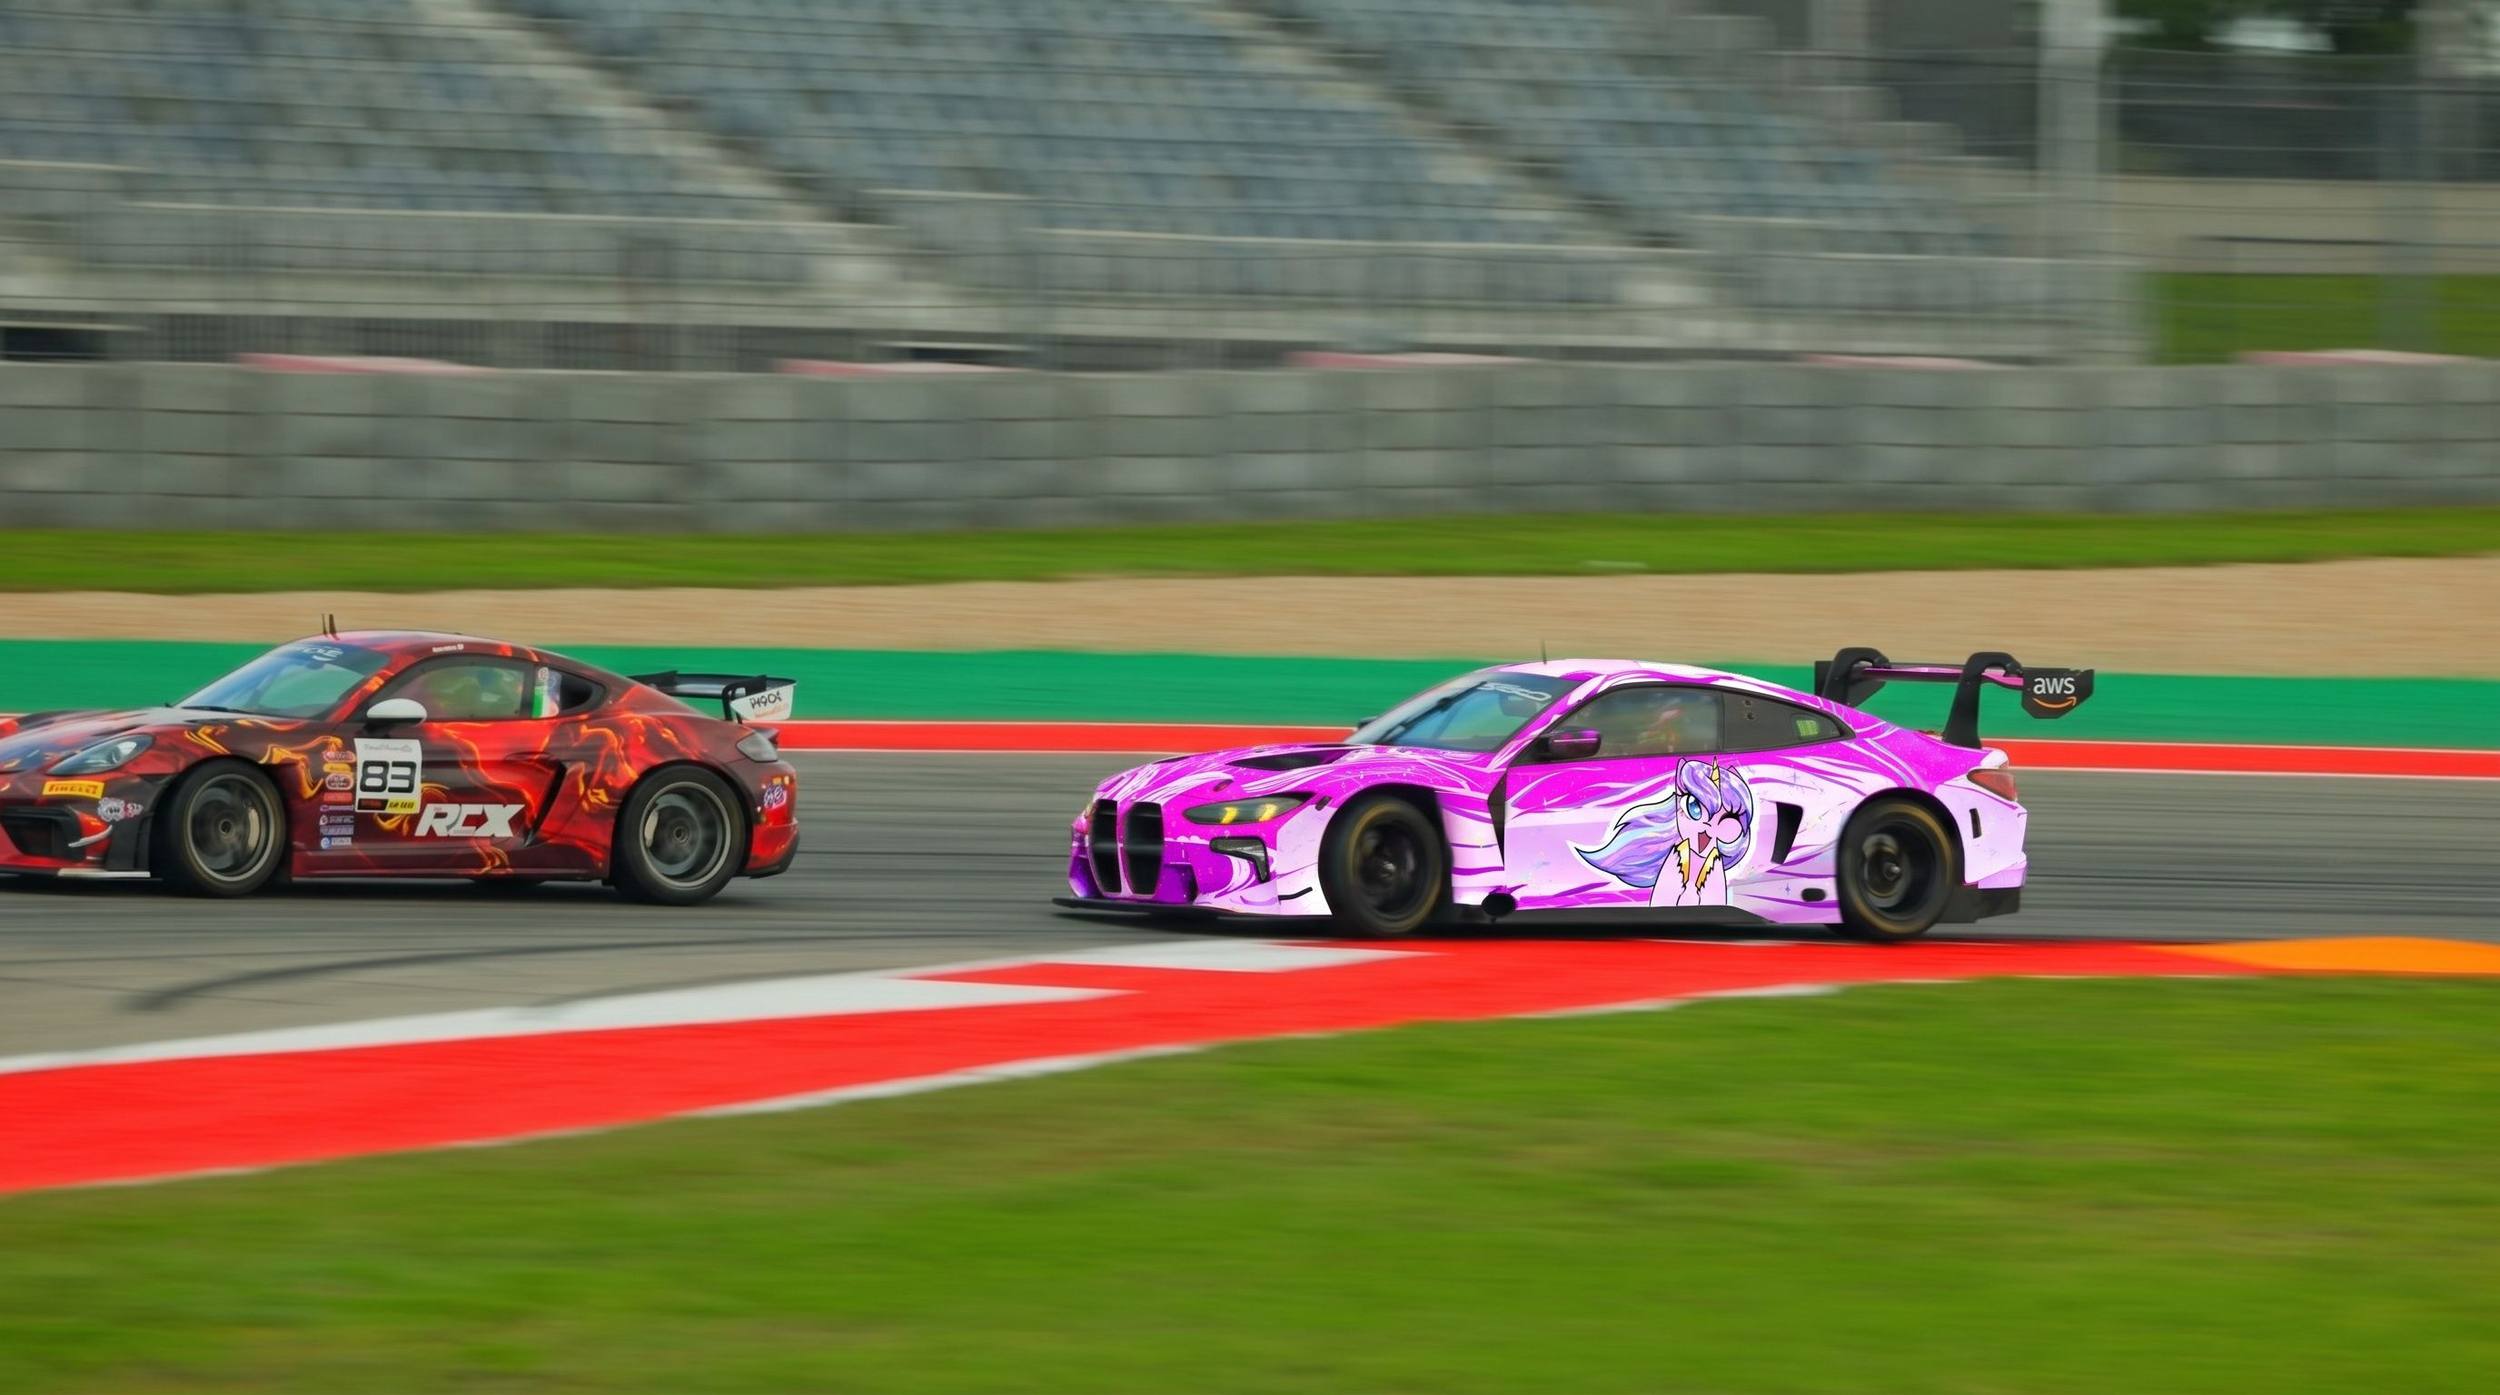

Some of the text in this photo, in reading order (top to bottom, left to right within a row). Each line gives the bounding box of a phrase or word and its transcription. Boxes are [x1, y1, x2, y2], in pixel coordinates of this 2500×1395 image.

[2033, 677, 2076, 695] aws
[360, 760, 417, 794] 83
[414, 803, 525, 837] RCX
